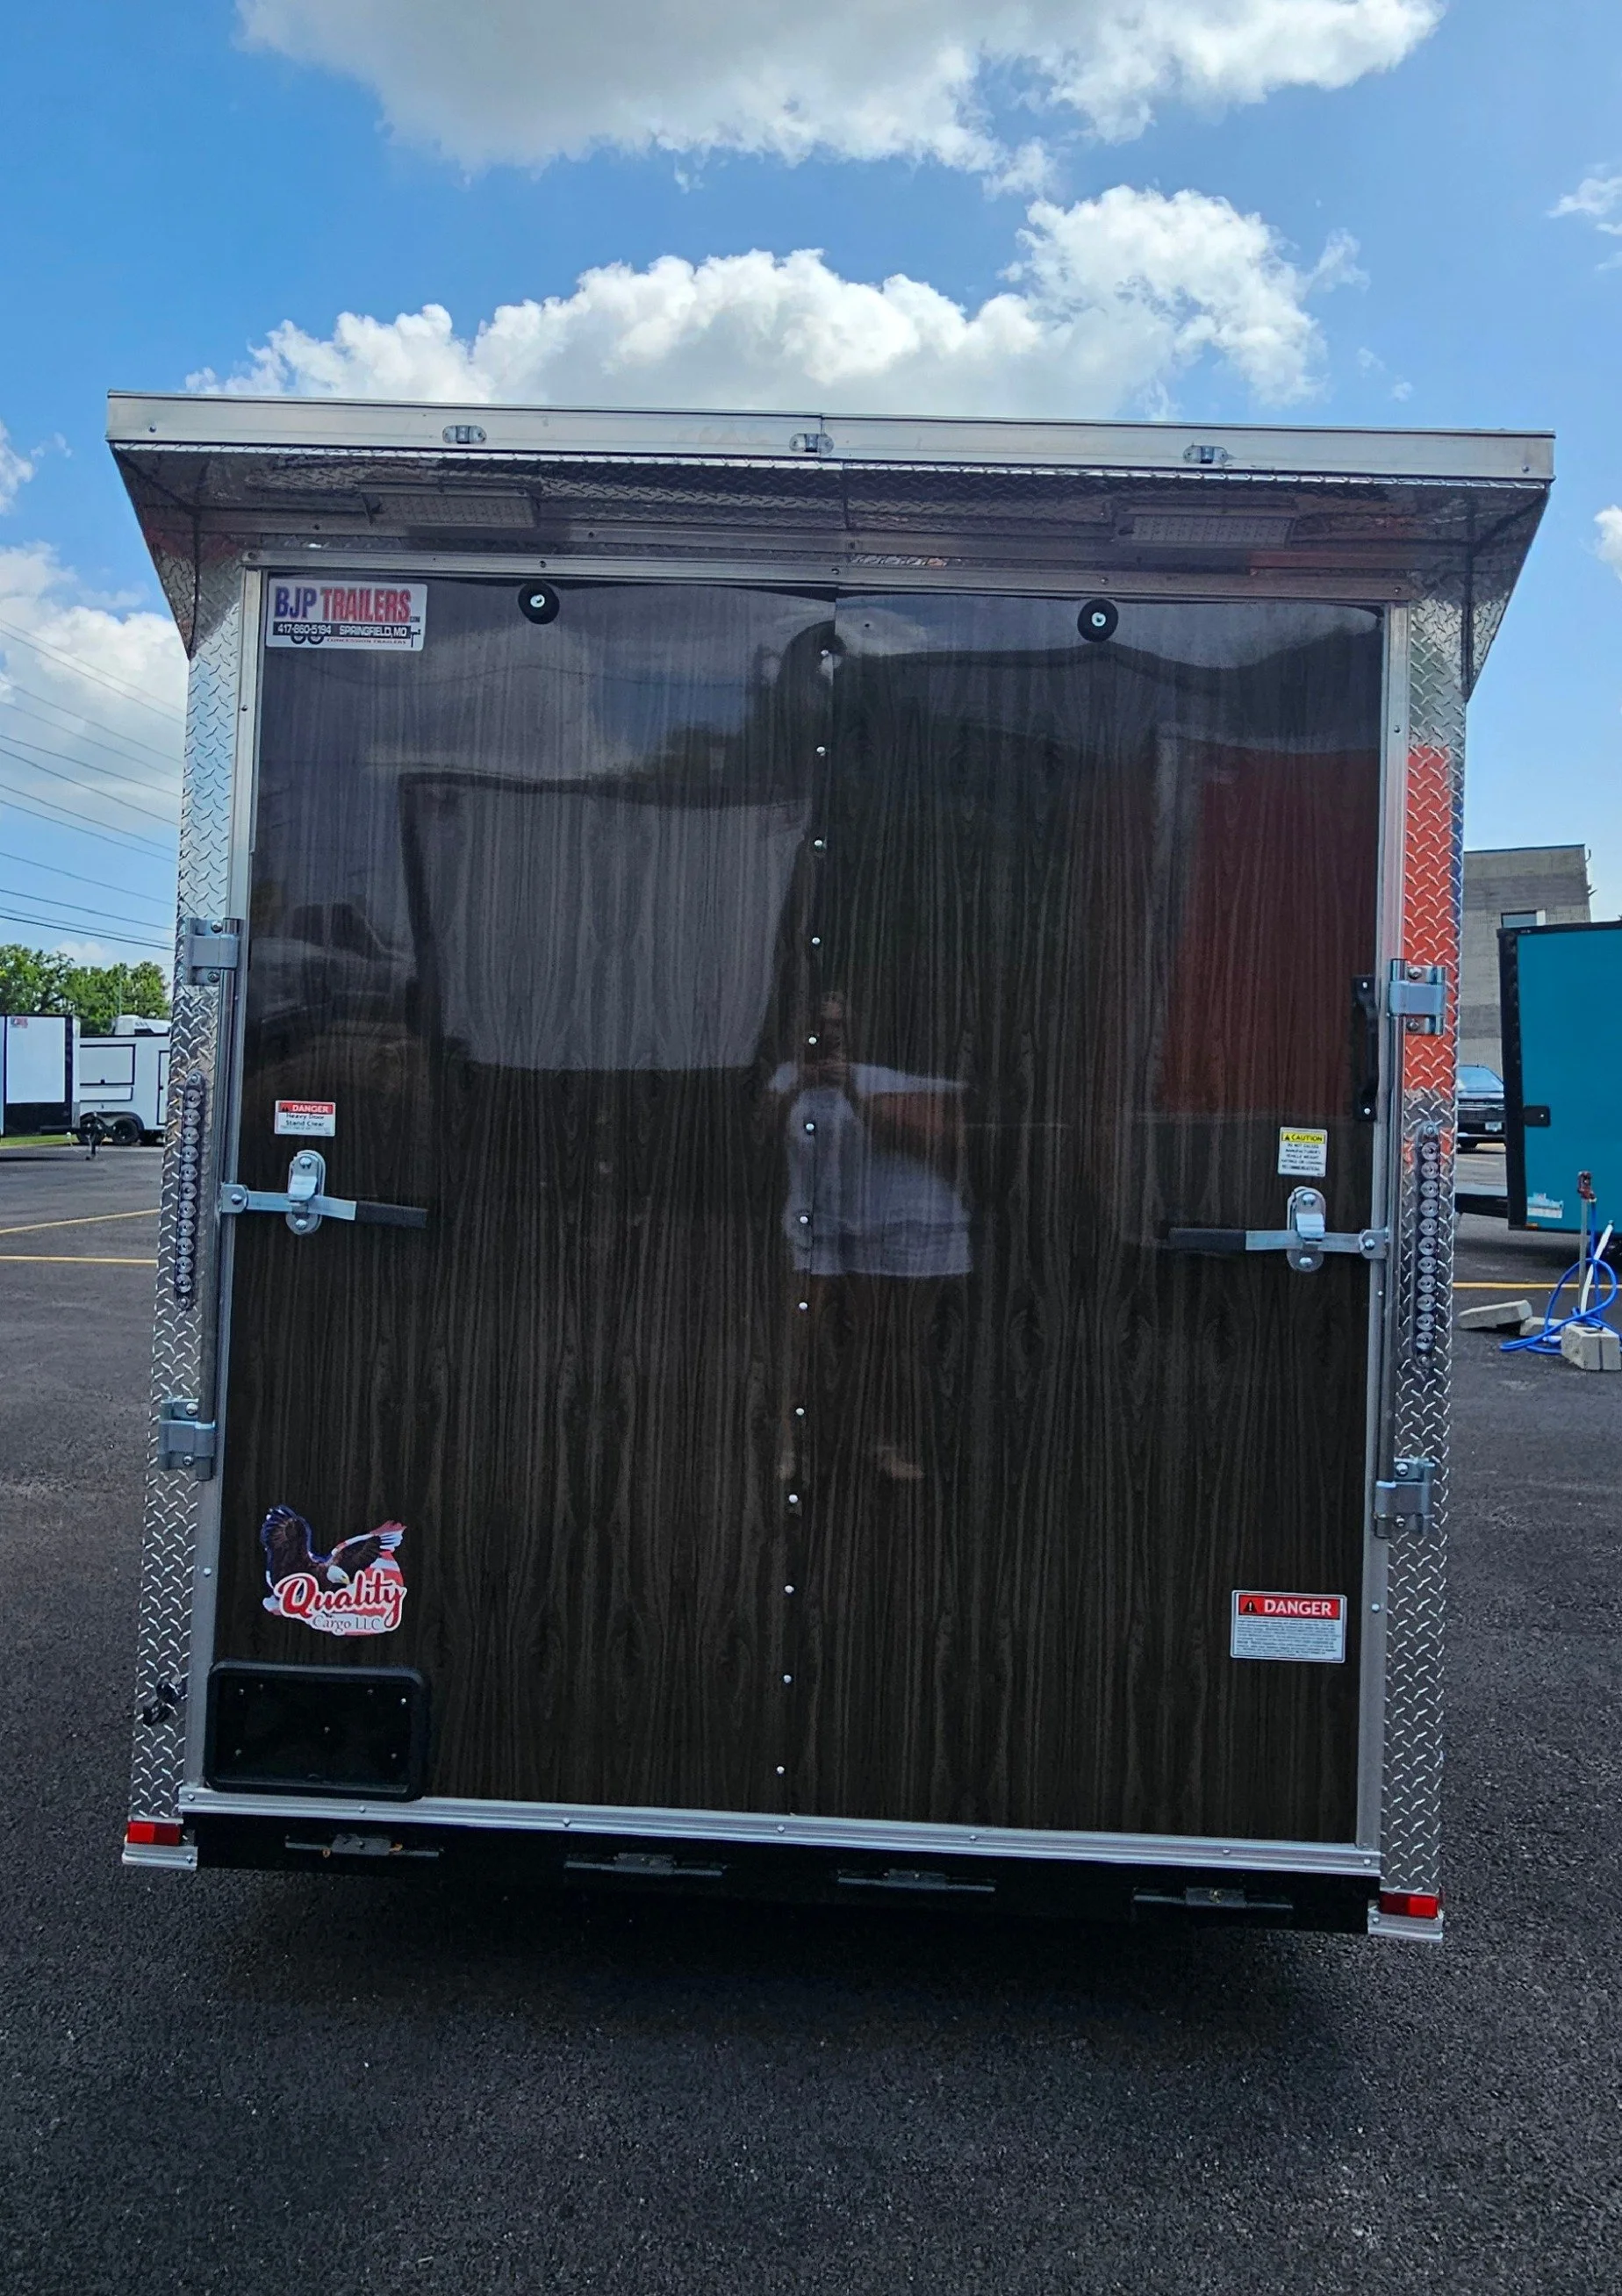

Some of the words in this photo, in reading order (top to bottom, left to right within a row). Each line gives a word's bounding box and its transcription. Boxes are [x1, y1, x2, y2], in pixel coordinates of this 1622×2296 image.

[274, 586, 317, 619] BJP
[320, 587, 412, 623] TRAILERS
[394, 628, 407, 637] MO
[292, 1104, 328, 1113] DANGER
[276, 1569, 404, 1628] Quality
[1264, 1599, 1332, 1616] DANGER
[312, 1615, 351, 1632] Cargo
[355, 1618, 381, 1631] LLC
